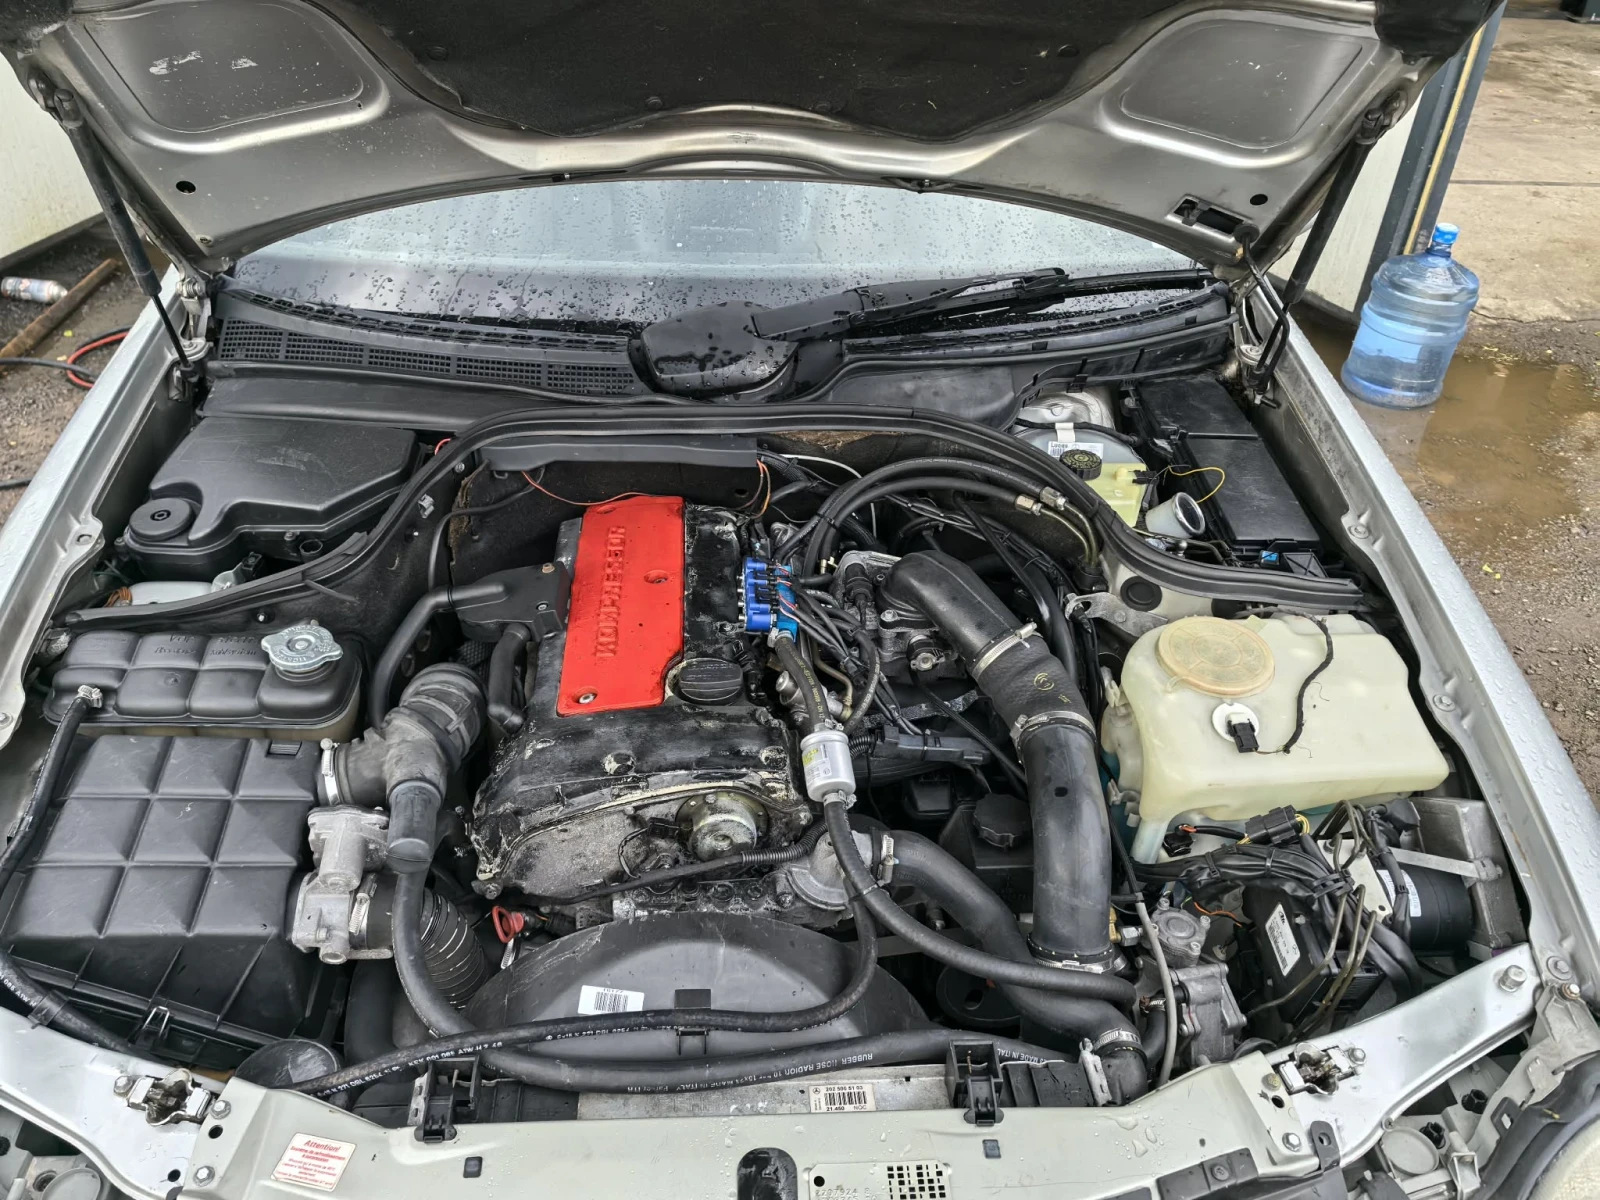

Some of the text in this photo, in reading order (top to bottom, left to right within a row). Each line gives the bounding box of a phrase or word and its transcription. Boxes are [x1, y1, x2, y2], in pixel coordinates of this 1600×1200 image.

[595, 526, 626, 658] KOMPRESSOR
[841, 1052, 873, 1066] RUBBER
[1011, 1051, 1019, 1059] IN
[304, 1140, 341, 1152] Attention!
